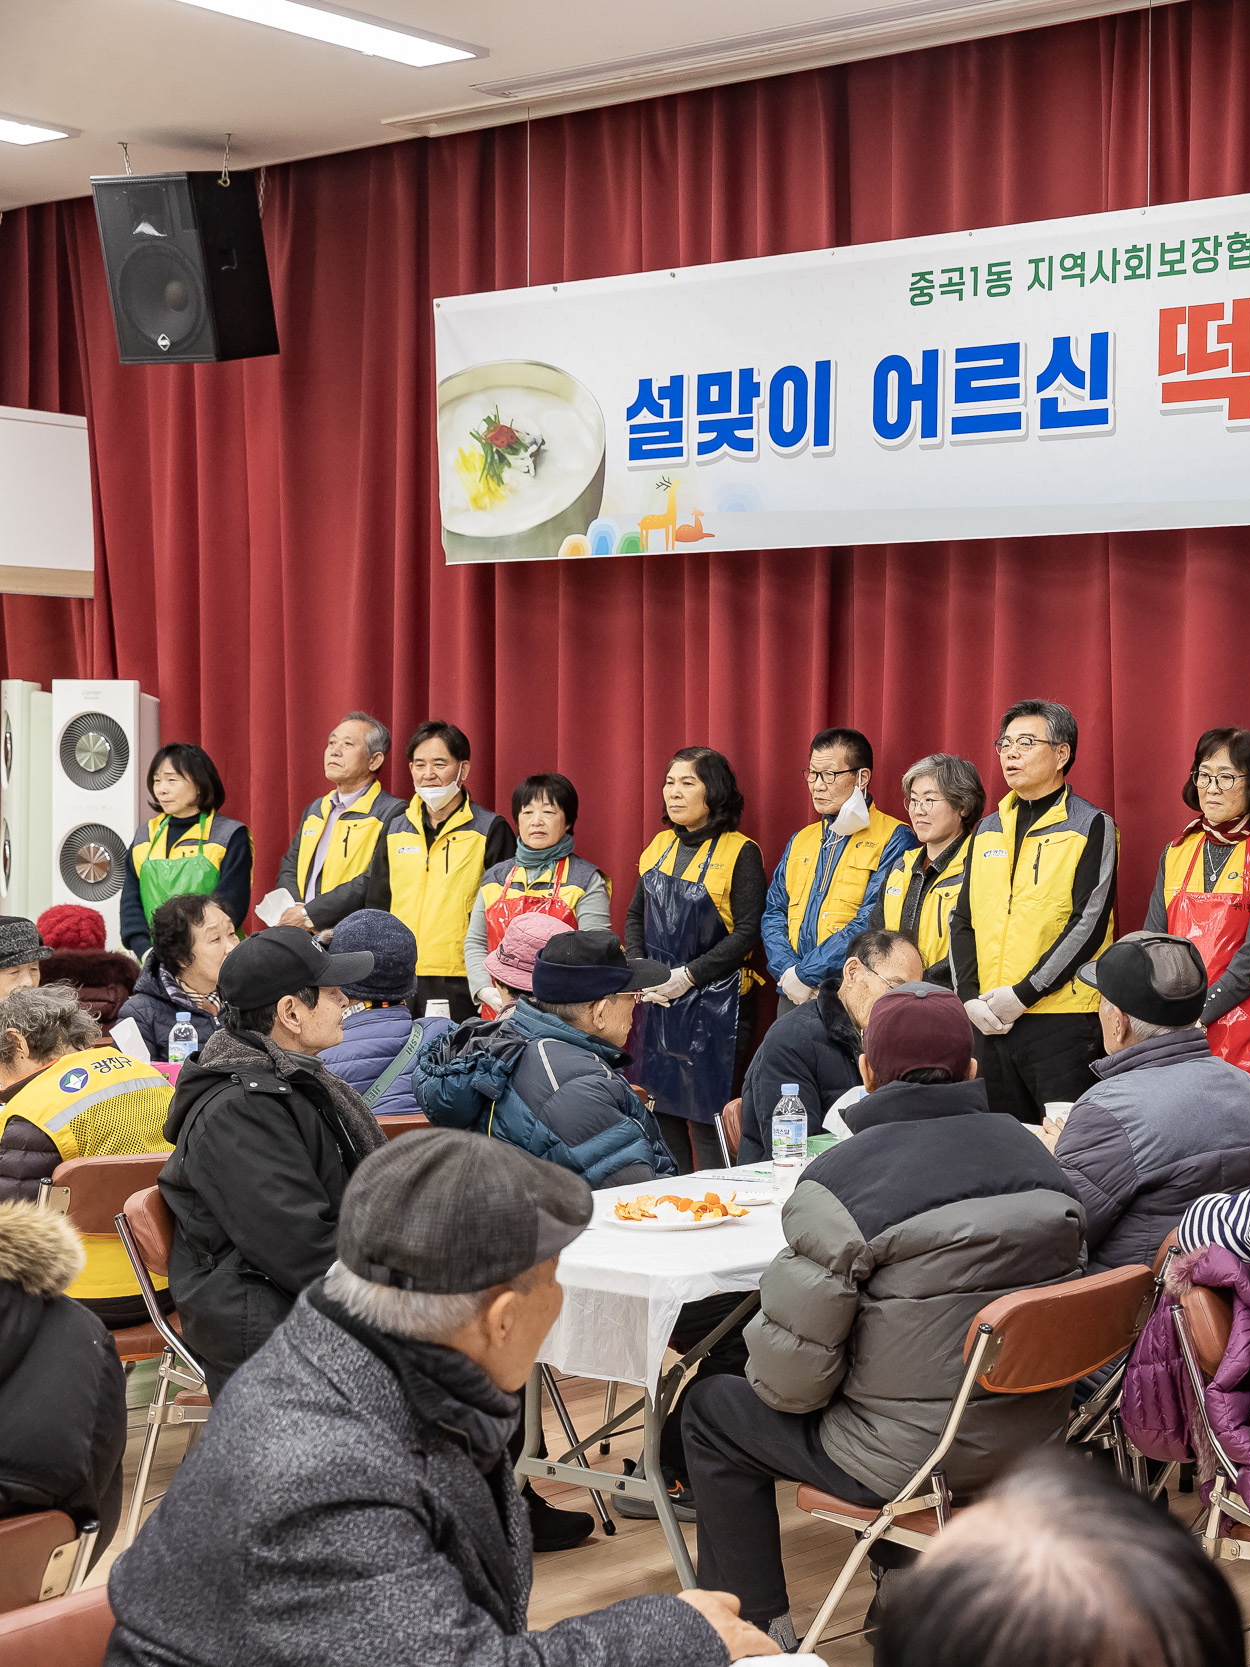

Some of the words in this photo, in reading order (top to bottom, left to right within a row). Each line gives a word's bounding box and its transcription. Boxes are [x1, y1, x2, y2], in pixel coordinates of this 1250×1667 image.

[909, 261, 1013, 306] 중곡1동
[626, 360, 831, 461] 설맞이
[872, 331, 1109, 440] 어르신
[90, 1056, 133, 1074] 광진구
